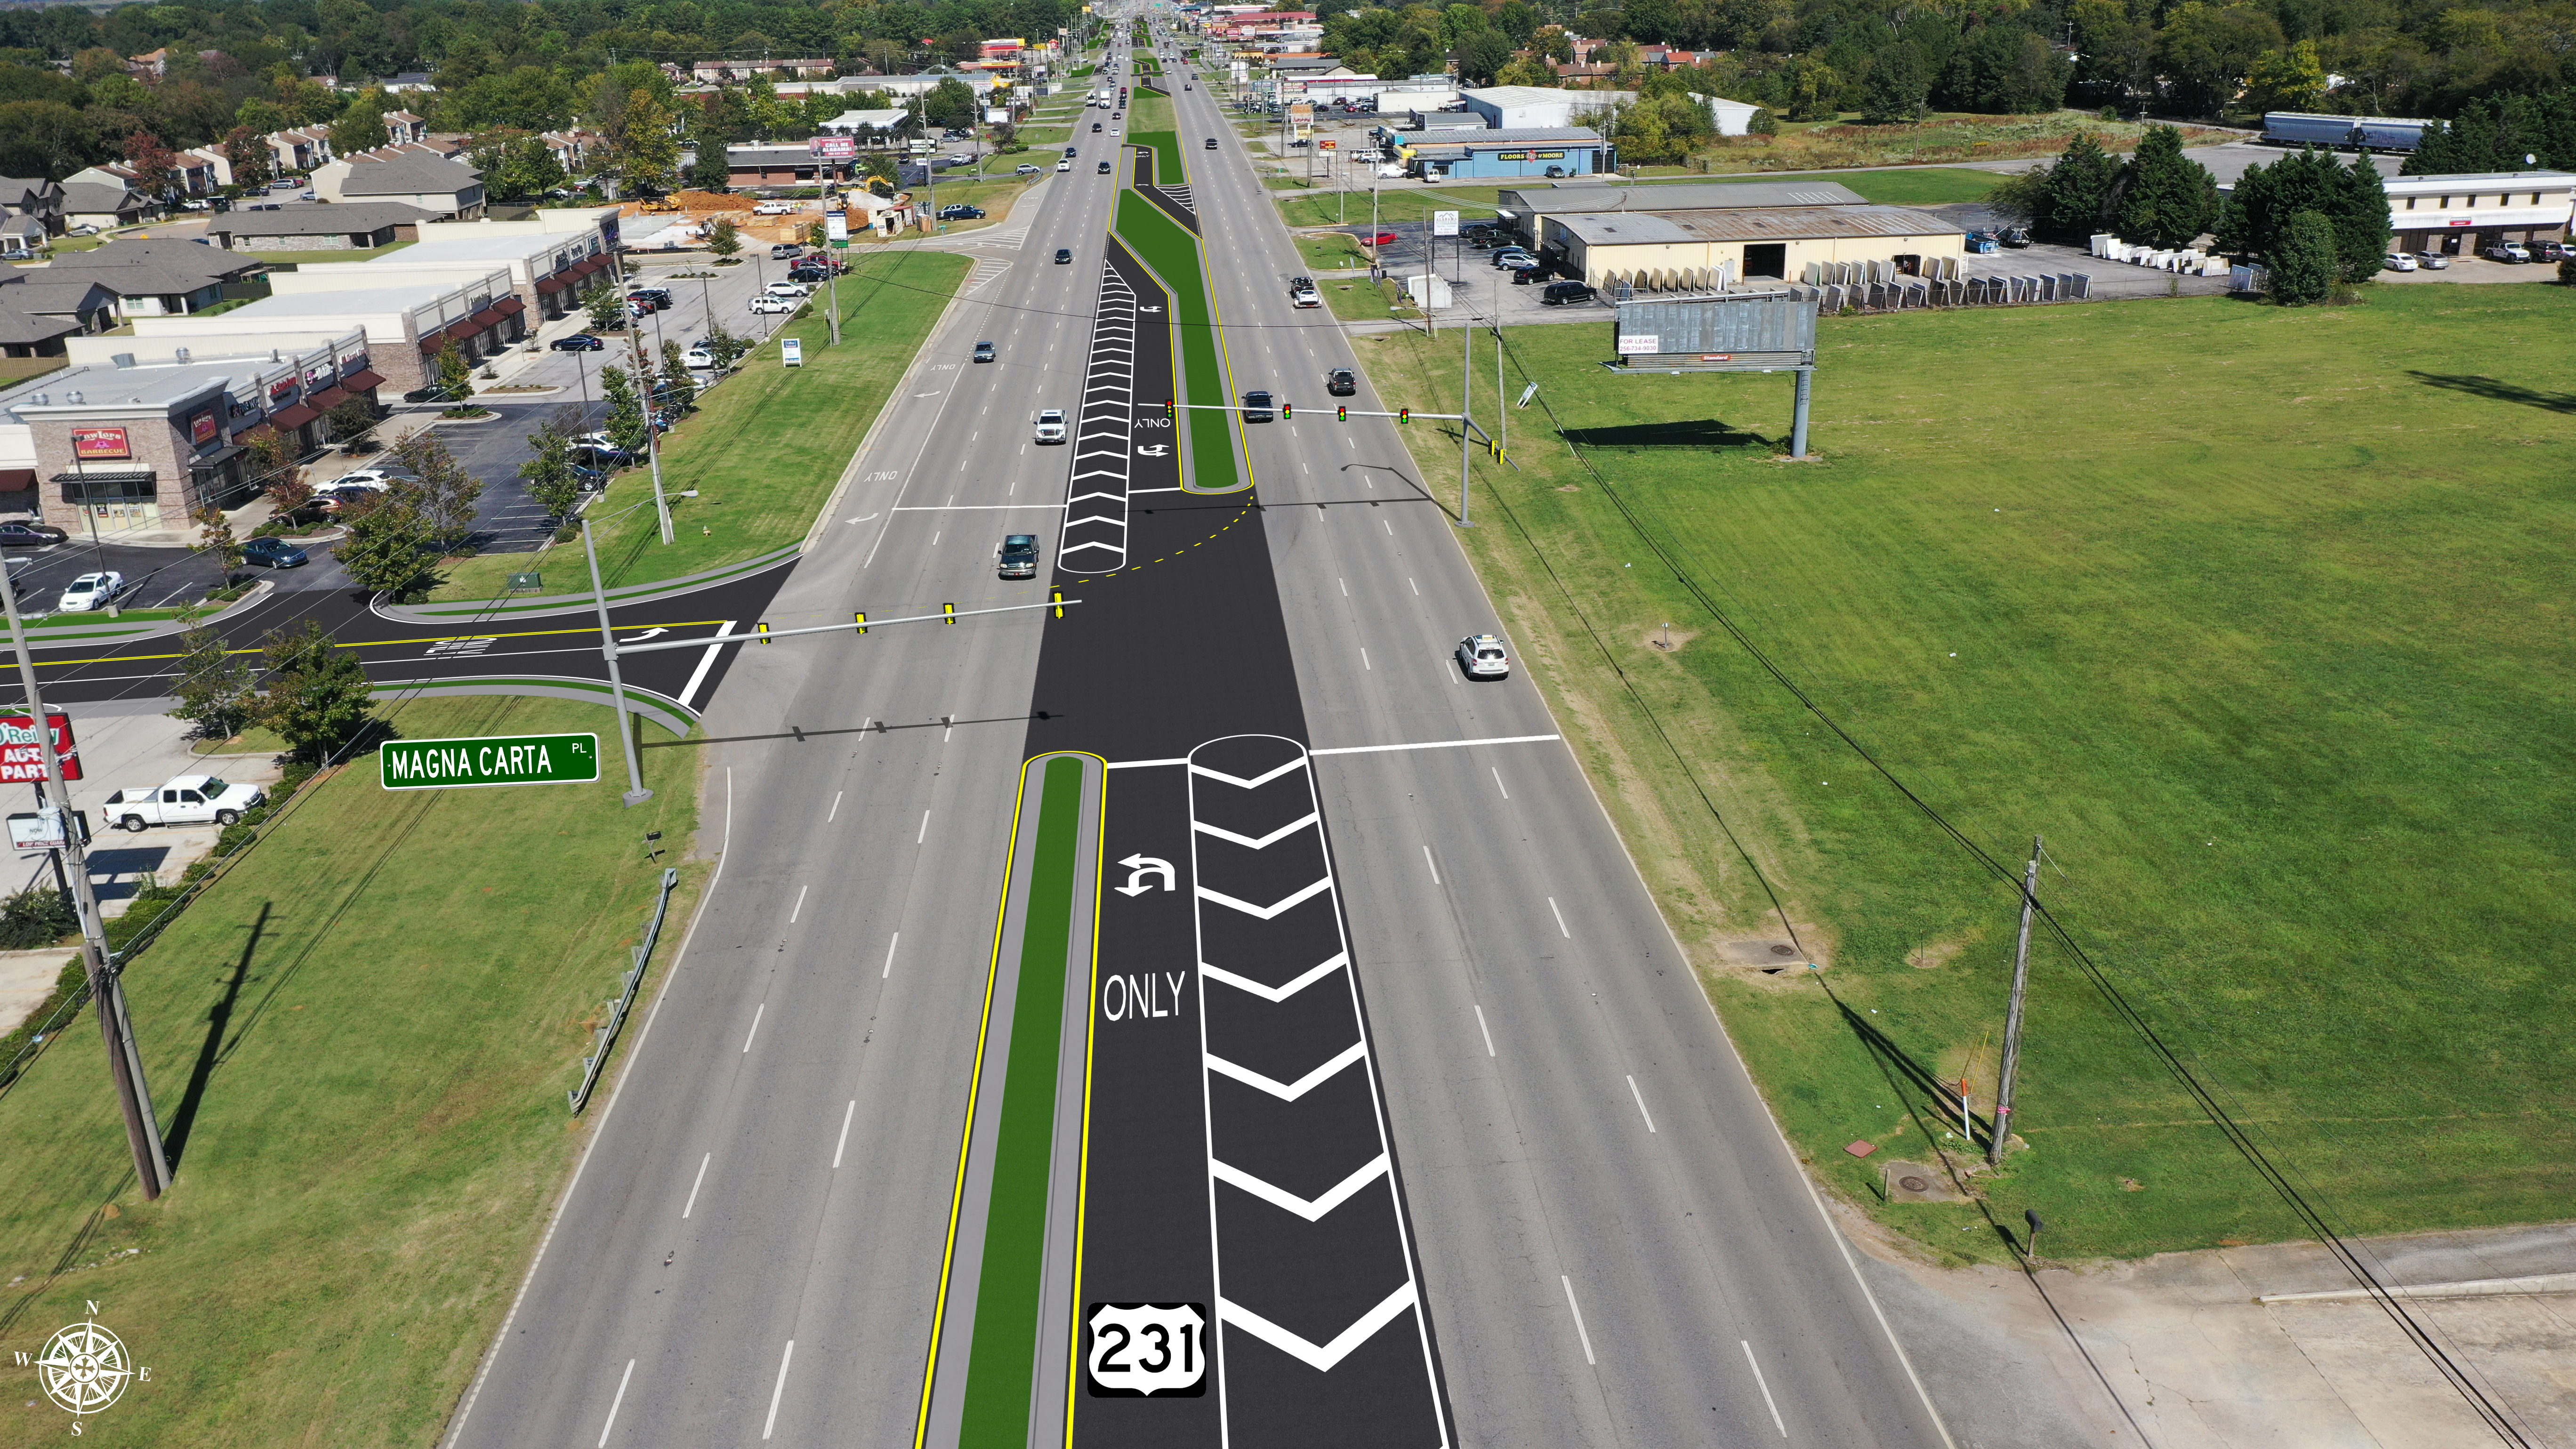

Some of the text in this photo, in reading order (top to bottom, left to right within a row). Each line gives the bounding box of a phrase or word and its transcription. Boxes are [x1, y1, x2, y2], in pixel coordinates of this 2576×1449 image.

[1134, 418, 1170, 428] ONLY
[863, 471, 898, 483] ONLY
[423, 637, 498, 656] ONLY
[4, 747, 43, 763] AUT
[0, 764, 49, 780] PART
[1104, 971, 1185, 1021] ONLY
